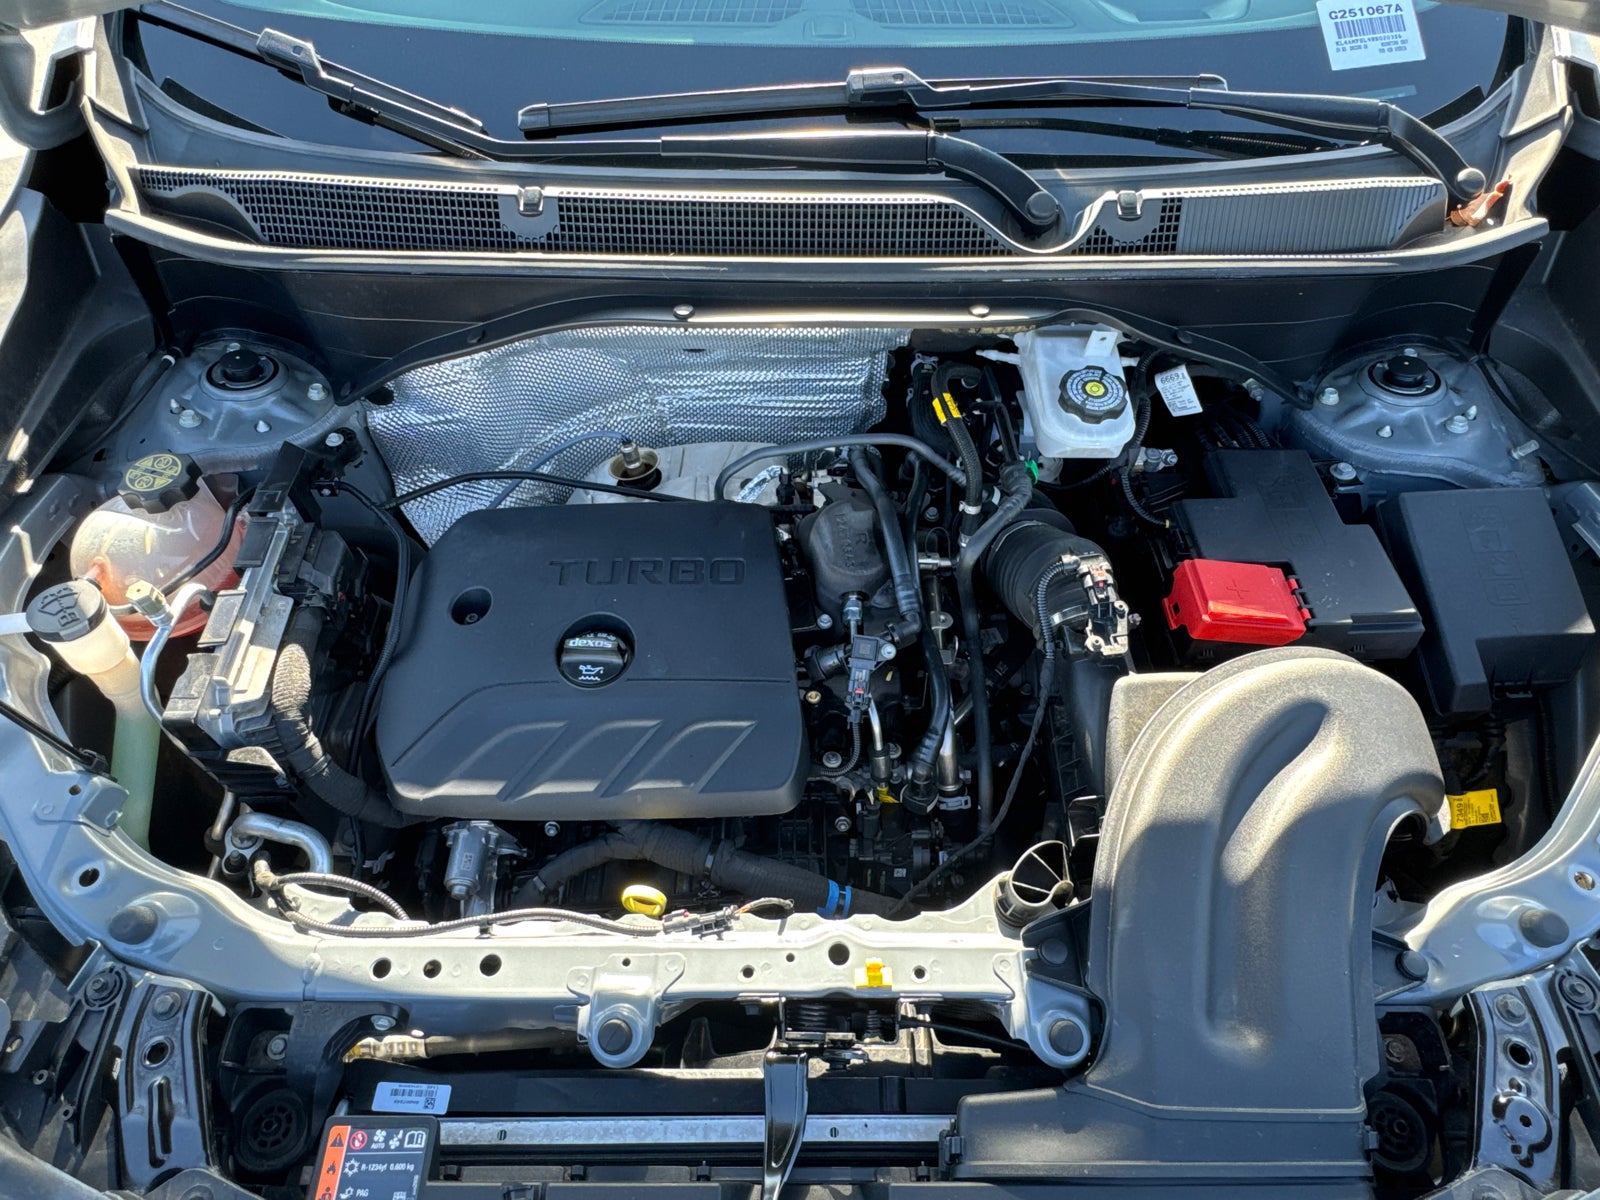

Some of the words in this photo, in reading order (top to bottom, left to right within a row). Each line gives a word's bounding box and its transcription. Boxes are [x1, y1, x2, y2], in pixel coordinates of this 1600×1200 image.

[1329, 4, 1403, 20] G251067A
[549, 557, 746, 587] TURBO
[568, 637, 613, 649] dexos
[407, 1163, 414, 1172] kg
[356, 1189, 369, 1197] PAG
